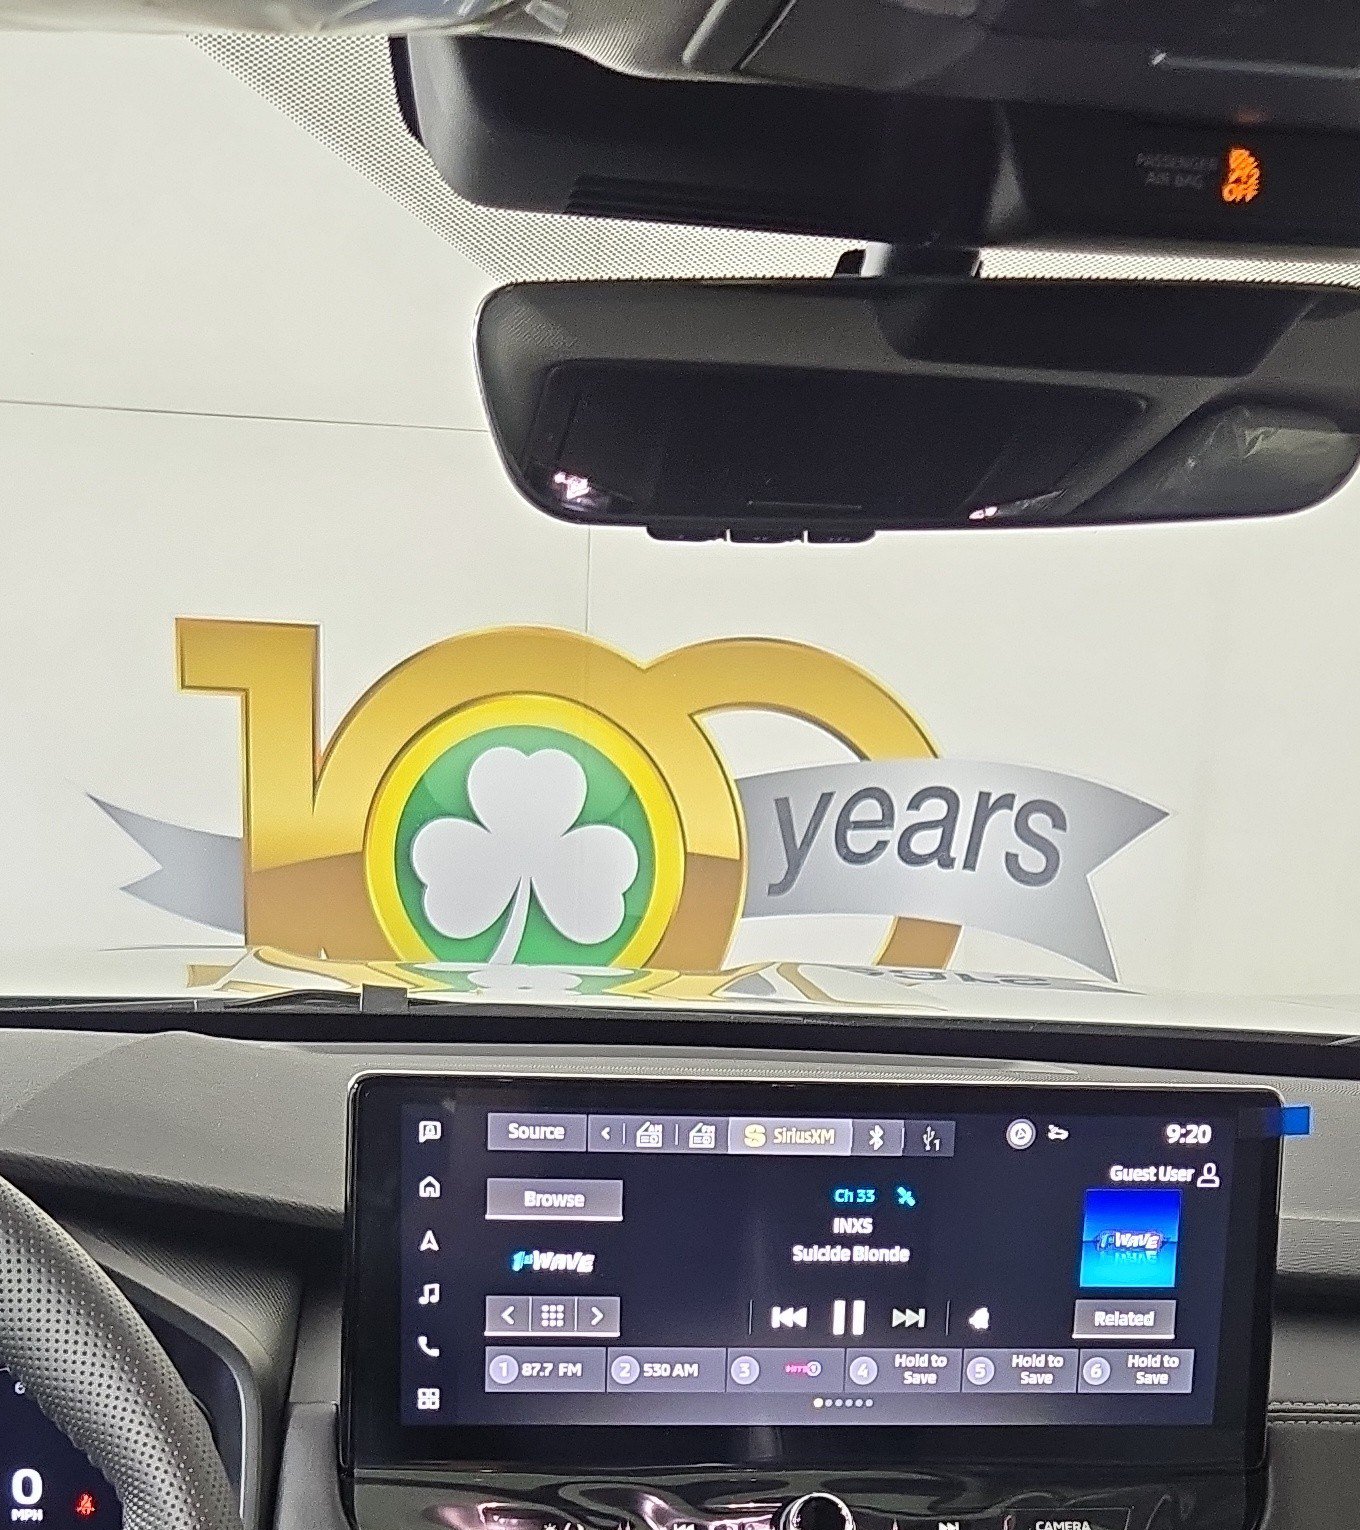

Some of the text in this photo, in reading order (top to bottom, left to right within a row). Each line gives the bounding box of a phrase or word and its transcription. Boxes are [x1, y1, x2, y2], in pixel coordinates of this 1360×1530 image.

[767, 784, 1068, 896] years
[508, 1123, 565, 1139] Source
[774, 1127, 835, 1145] SiriusXM
[1166, 1124, 1212, 1144] 9:20
[1110, 1165, 1195, 1181] Guest User
[524, 1191, 585, 1207] Browse
[834, 1188, 875, 1203] Ch 33
[833, 1217, 873, 1234] INXS
[793, 1244, 910, 1263] Suicide Blonde
[1094, 1311, 1155, 1327] Related
[894, 1354, 948, 1368] Hold to
[1011, 1354, 1064, 1368] Hold to
[1127, 1354, 1180, 1368] Hold to
[499, 1362, 582, 1377] 1 87.7 FM
[620, 1363, 699, 1377] 2 530 AM
[739, 1363, 750, 1378] 3
[857, 1363, 869, 1378] 4
[975, 1363, 986, 1378] 5
[1090, 1363, 1102, 1378] 6
[903, 1372, 937, 1385] Save
[1020, 1372, 1053, 1385] Save
[1135, 1372, 1169, 1385] Save
[11, 1468, 43, 1505] 0
[11, 1508, 43, 1522] MPH
